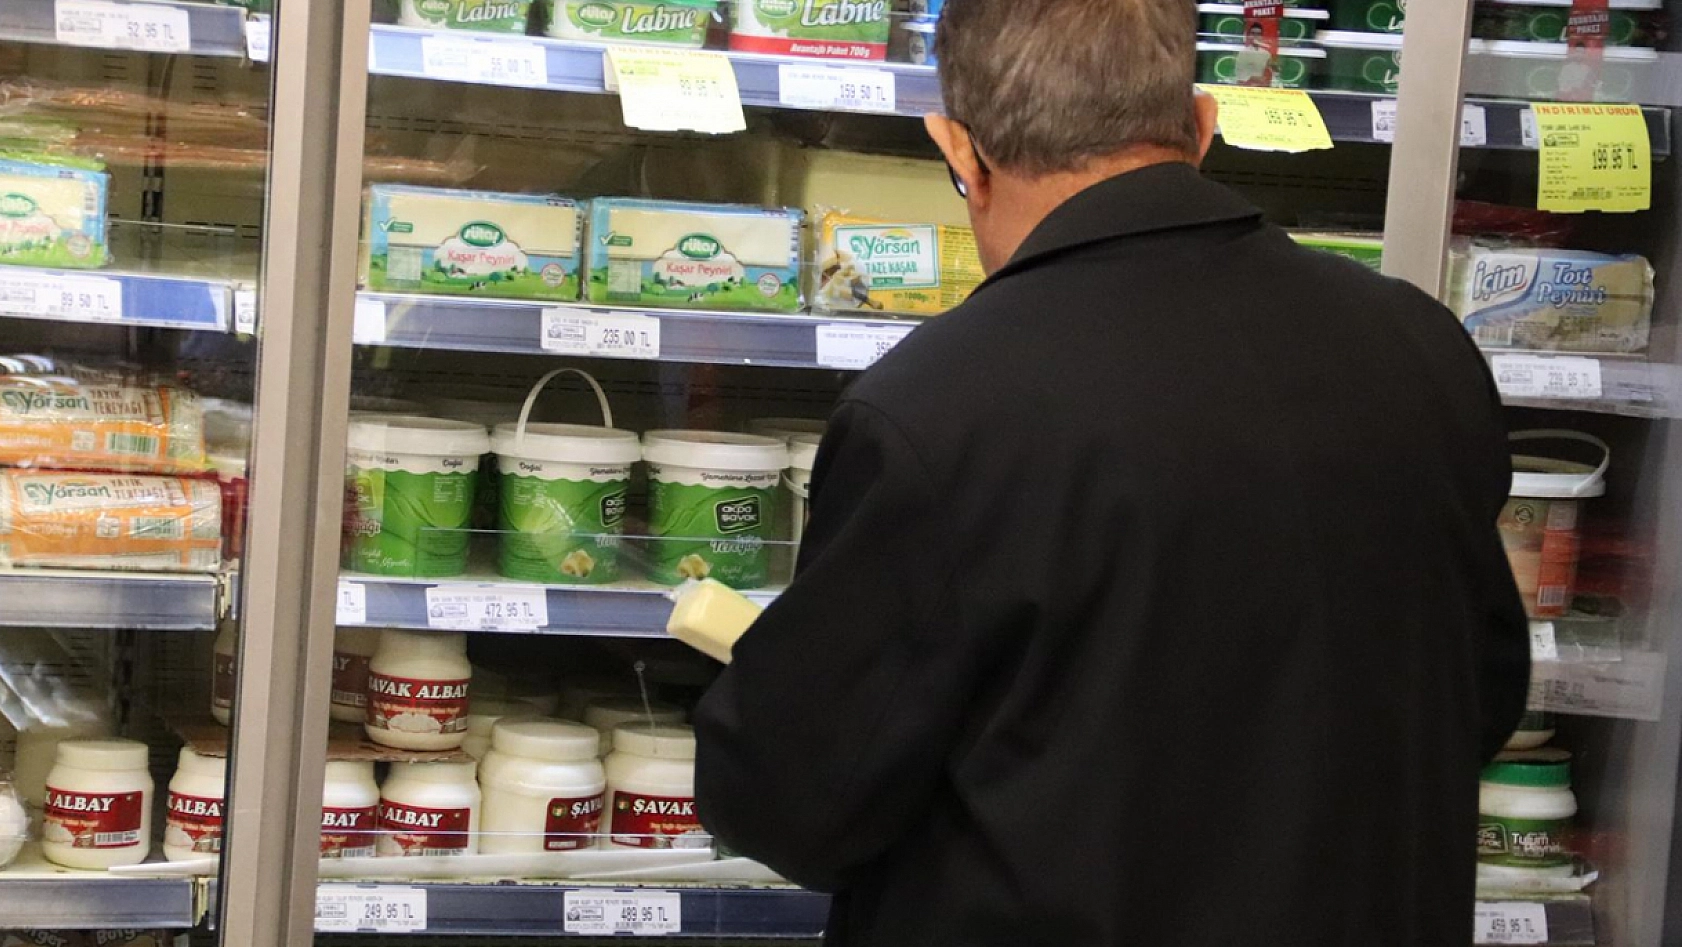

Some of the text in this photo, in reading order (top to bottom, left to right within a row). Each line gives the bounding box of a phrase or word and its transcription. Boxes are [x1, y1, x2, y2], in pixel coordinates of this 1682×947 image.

[456, 0, 519, 22] Labne
[622, 5, 697, 34] Labne
[801, 0, 884, 26] Labne
[163, 24, 174, 40] TL
[524, 59, 536, 75] TL
[876, 86, 887, 102] TL
[1463, 119, 1475, 135] TL
[1627, 148, 1639, 170] TL
[861, 235, 921, 260] Yörsan
[665, 263, 695, 276] Kaşar
[1553, 261, 1593, 285] Tost
[1472, 260, 1527, 302] İçim
[96, 294, 109, 310] TL
[1537, 282, 1607, 310] Peyniri
[640, 330, 652, 348] TL
[1581, 372, 1593, 388] TL
[17, 391, 91, 414] Yörsan
[38, 482, 112, 505] Yörsan
[343, 590, 355, 606] TL
[521, 601, 534, 617] TL
[415, 682, 469, 699] ALBAY
[52, 793, 116, 812] ALBAY
[173, 797, 225, 817] ALBA
[632, 798, 696, 817] ŞAVAK
[321, 812, 361, 827] BAY
[384, 805, 443, 828] ALBAY
[402, 903, 414, 919] TL
[656, 906, 668, 922] TL
[1523, 917, 1535, 933] TL
